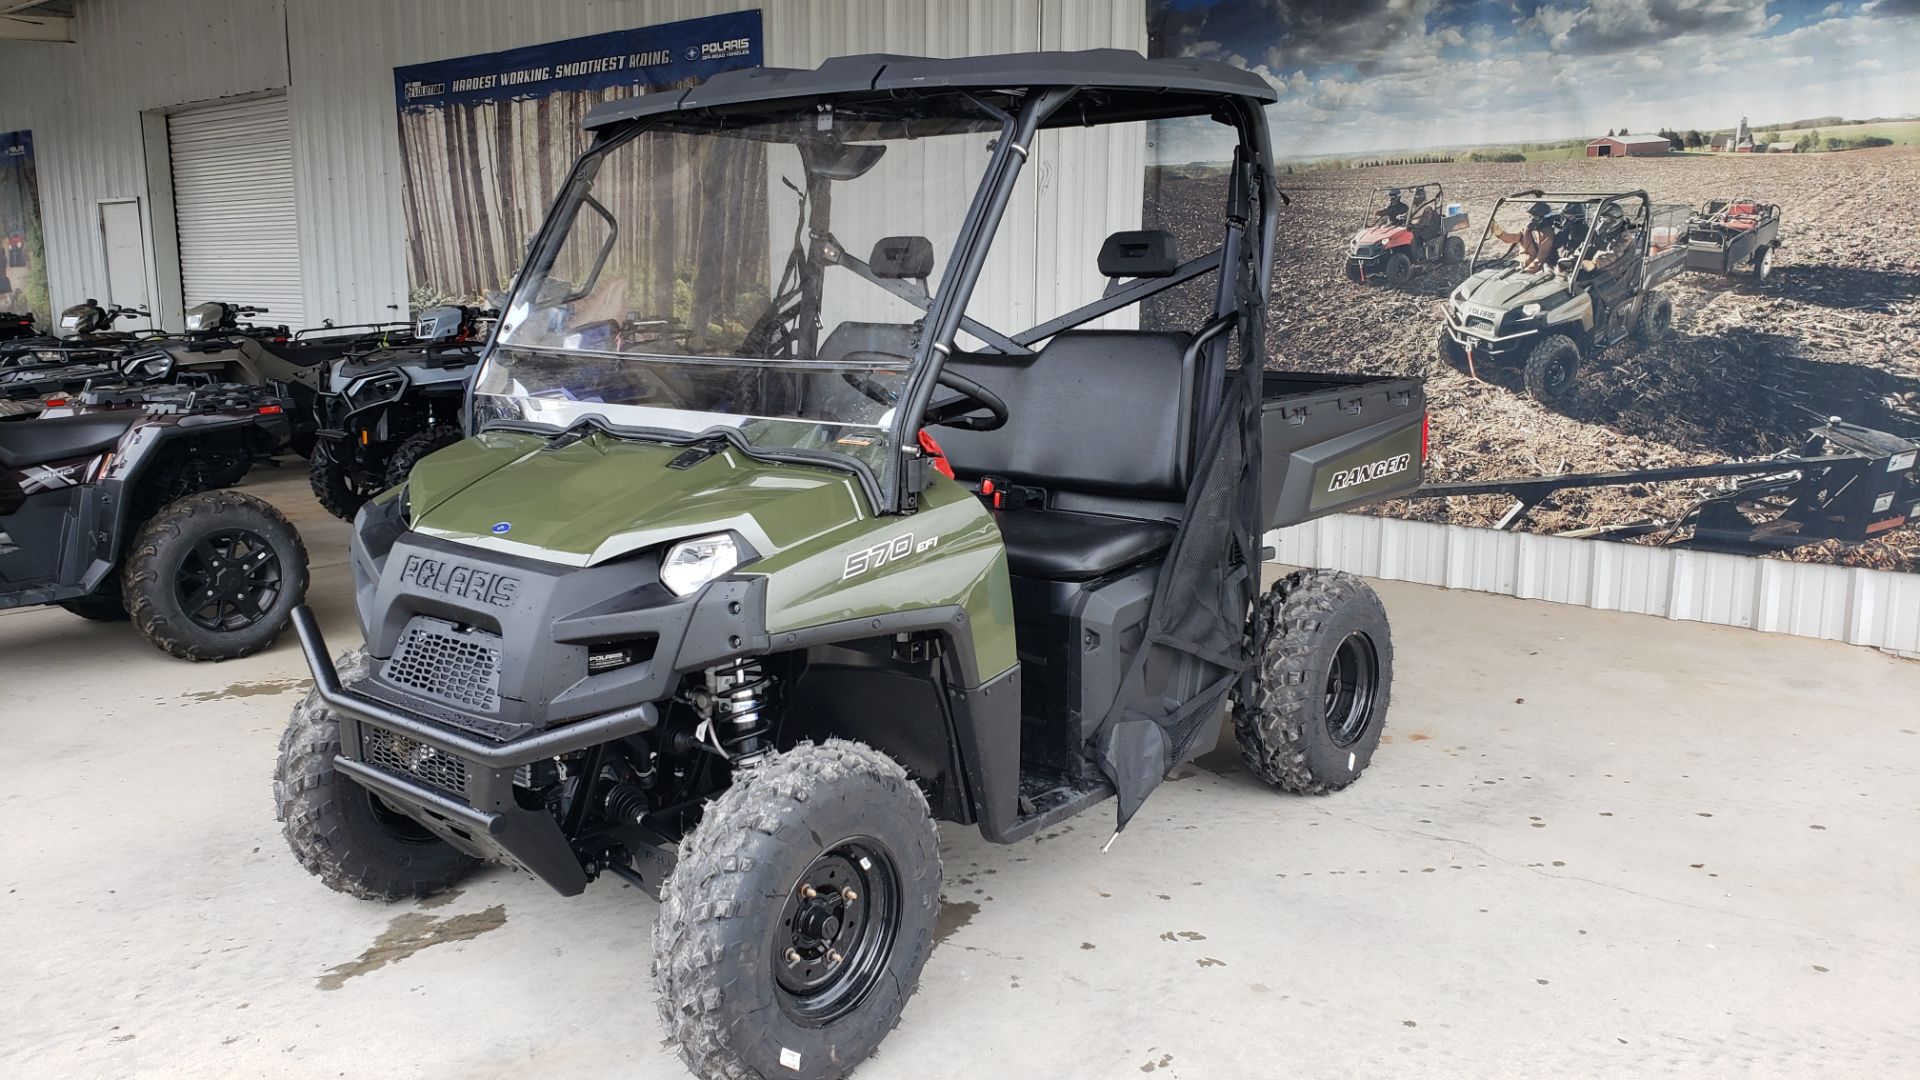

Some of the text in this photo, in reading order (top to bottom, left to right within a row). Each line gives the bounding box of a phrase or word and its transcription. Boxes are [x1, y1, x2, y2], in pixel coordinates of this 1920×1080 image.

[701, 38, 751, 54] POLARIS
[452, 75, 497, 93] HARDEST
[500, 67, 553, 86] WORKING.
[555, 55, 627, 78] SMOOTHEST
[1328, 453, 1410, 492] RANGER
[842, 532, 939, 580] 570 EFI
[400, 555, 520, 608] POLARIS
[589, 652, 623, 661] POLARIS
